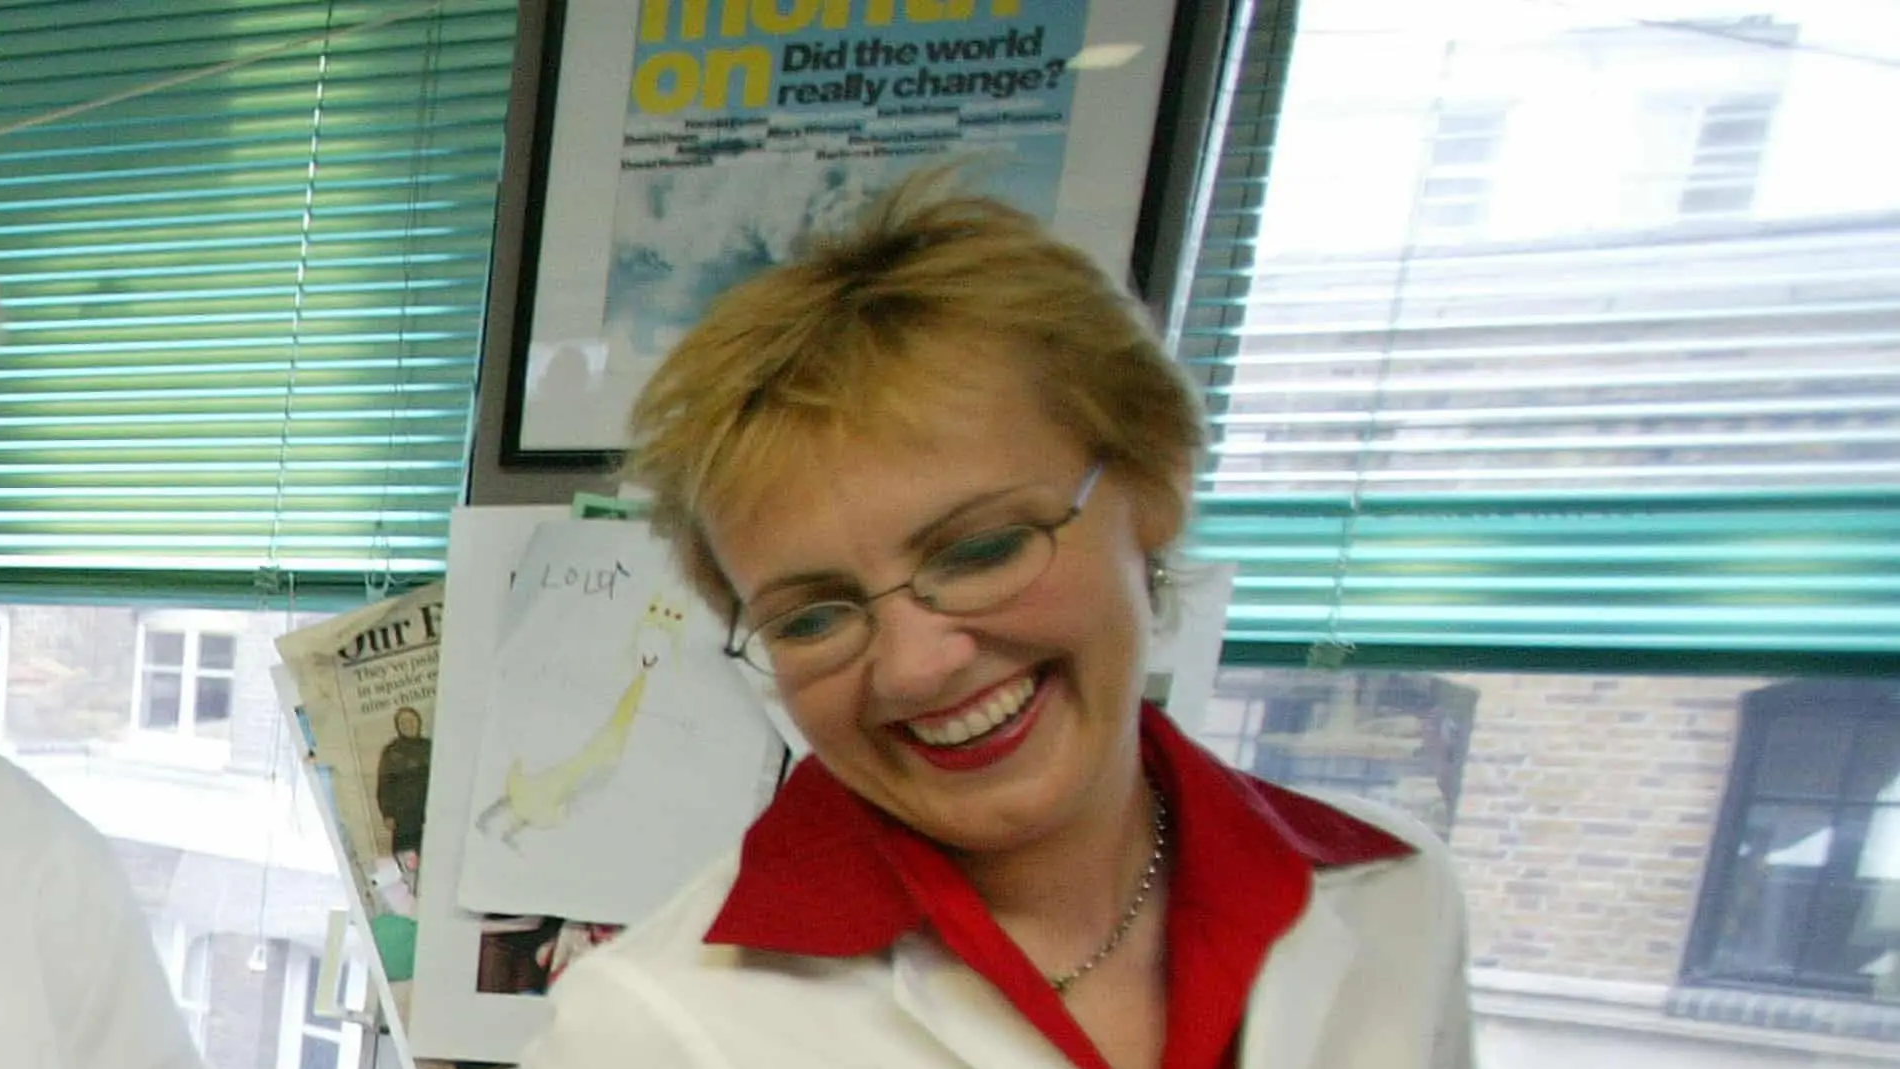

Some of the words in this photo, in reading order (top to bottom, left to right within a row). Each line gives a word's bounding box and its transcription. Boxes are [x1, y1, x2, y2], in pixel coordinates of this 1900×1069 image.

[781, 39, 849, 74] Did
[853, 35, 919, 68] the
[925, 25, 1046, 63] world
[632, 45, 772, 115] on
[776, 72, 887, 107] really
[892, 57, 1067, 99] change?
